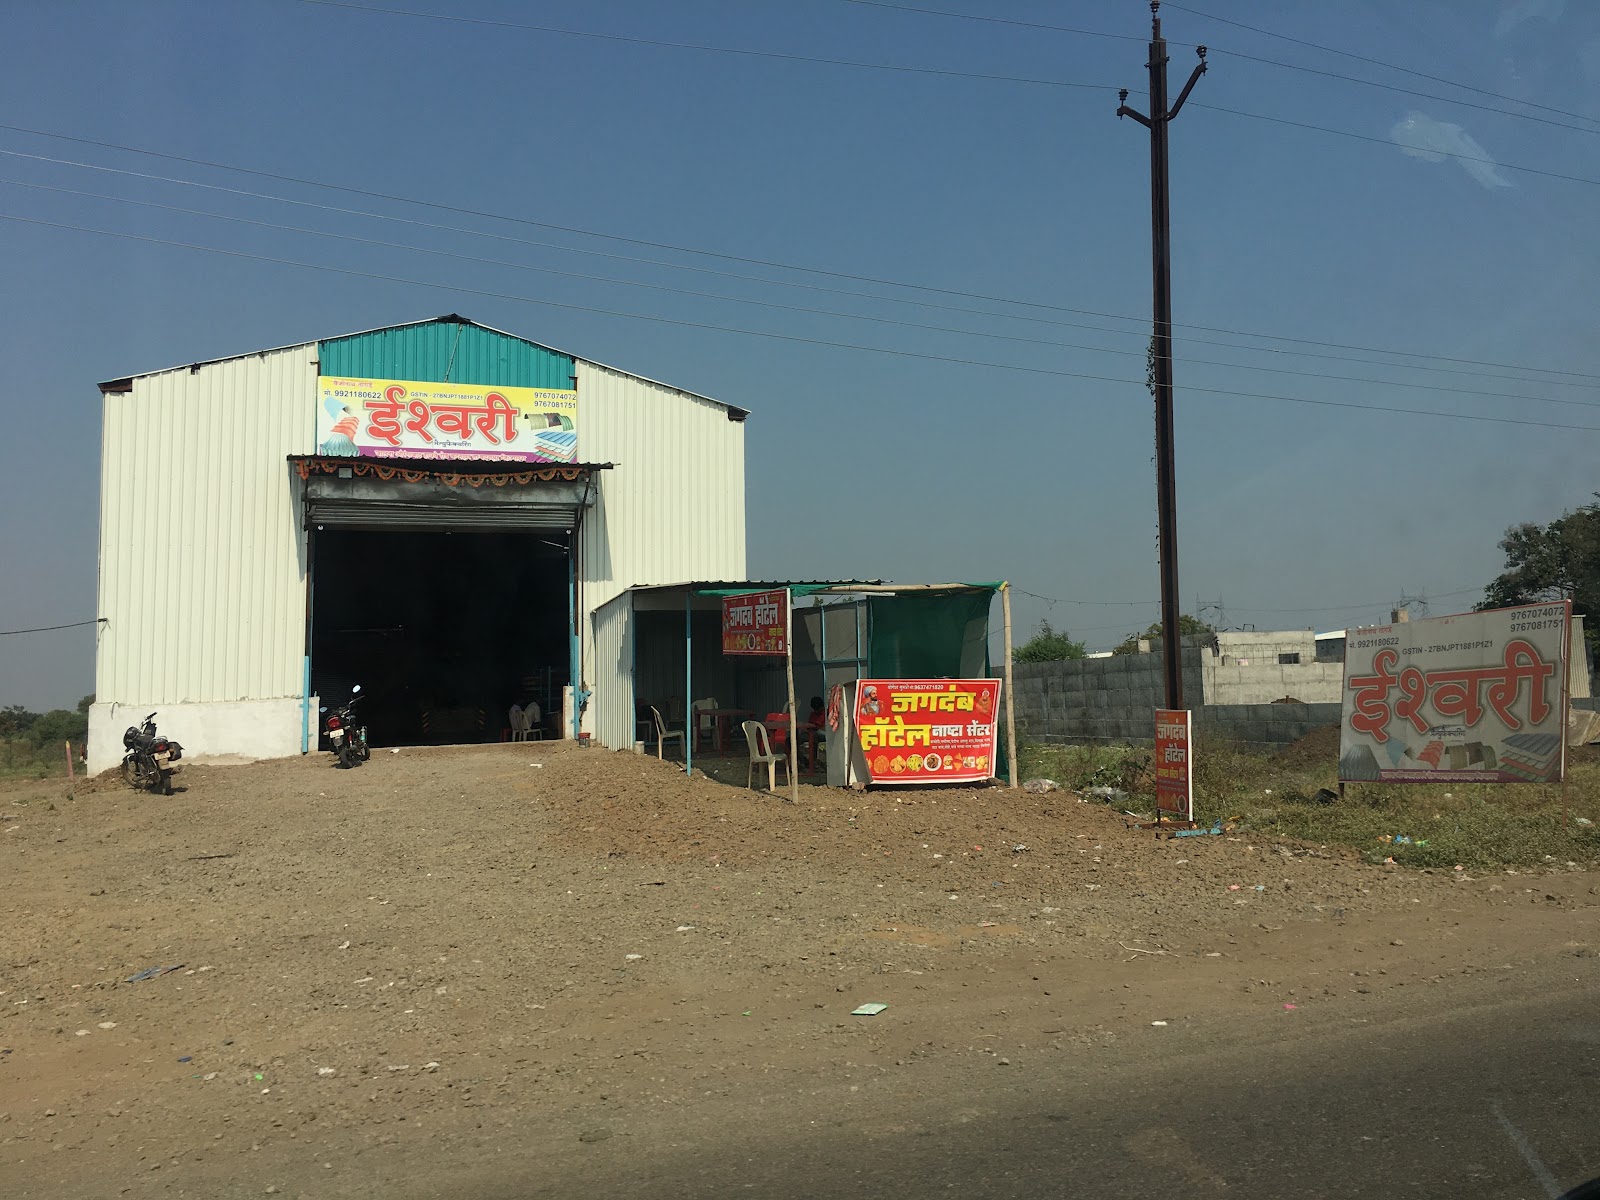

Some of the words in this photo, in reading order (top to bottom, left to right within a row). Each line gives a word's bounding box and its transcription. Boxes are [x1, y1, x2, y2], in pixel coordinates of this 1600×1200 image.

[334, 389, 382, 399] 9921180622
[534, 391, 577, 401] 9767074072
[534, 400, 576, 409] 9767081751
[364, 386, 518, 446] ईश्वरी
[1511, 606, 1565, 620] 9767074072
[1510, 619, 1564, 632] 9767081751
[1357, 637, 1400, 649] 9921180622
[1402, 646, 1423, 656] GSTIN
[1428, 640, 1493, 653] 27BNJPT1881P1Z1
[891, 684, 976, 713] जगदंब
[1349, 640, 1554, 743] ईश्वरी
[860, 715, 932, 751] हॉटेल
[931, 724, 963, 737] नाष्टा
[966, 719, 991, 737] सेंटर
[1157, 718, 1187, 740] जगदंब
[1164, 743, 1186, 763] हॉटेल
